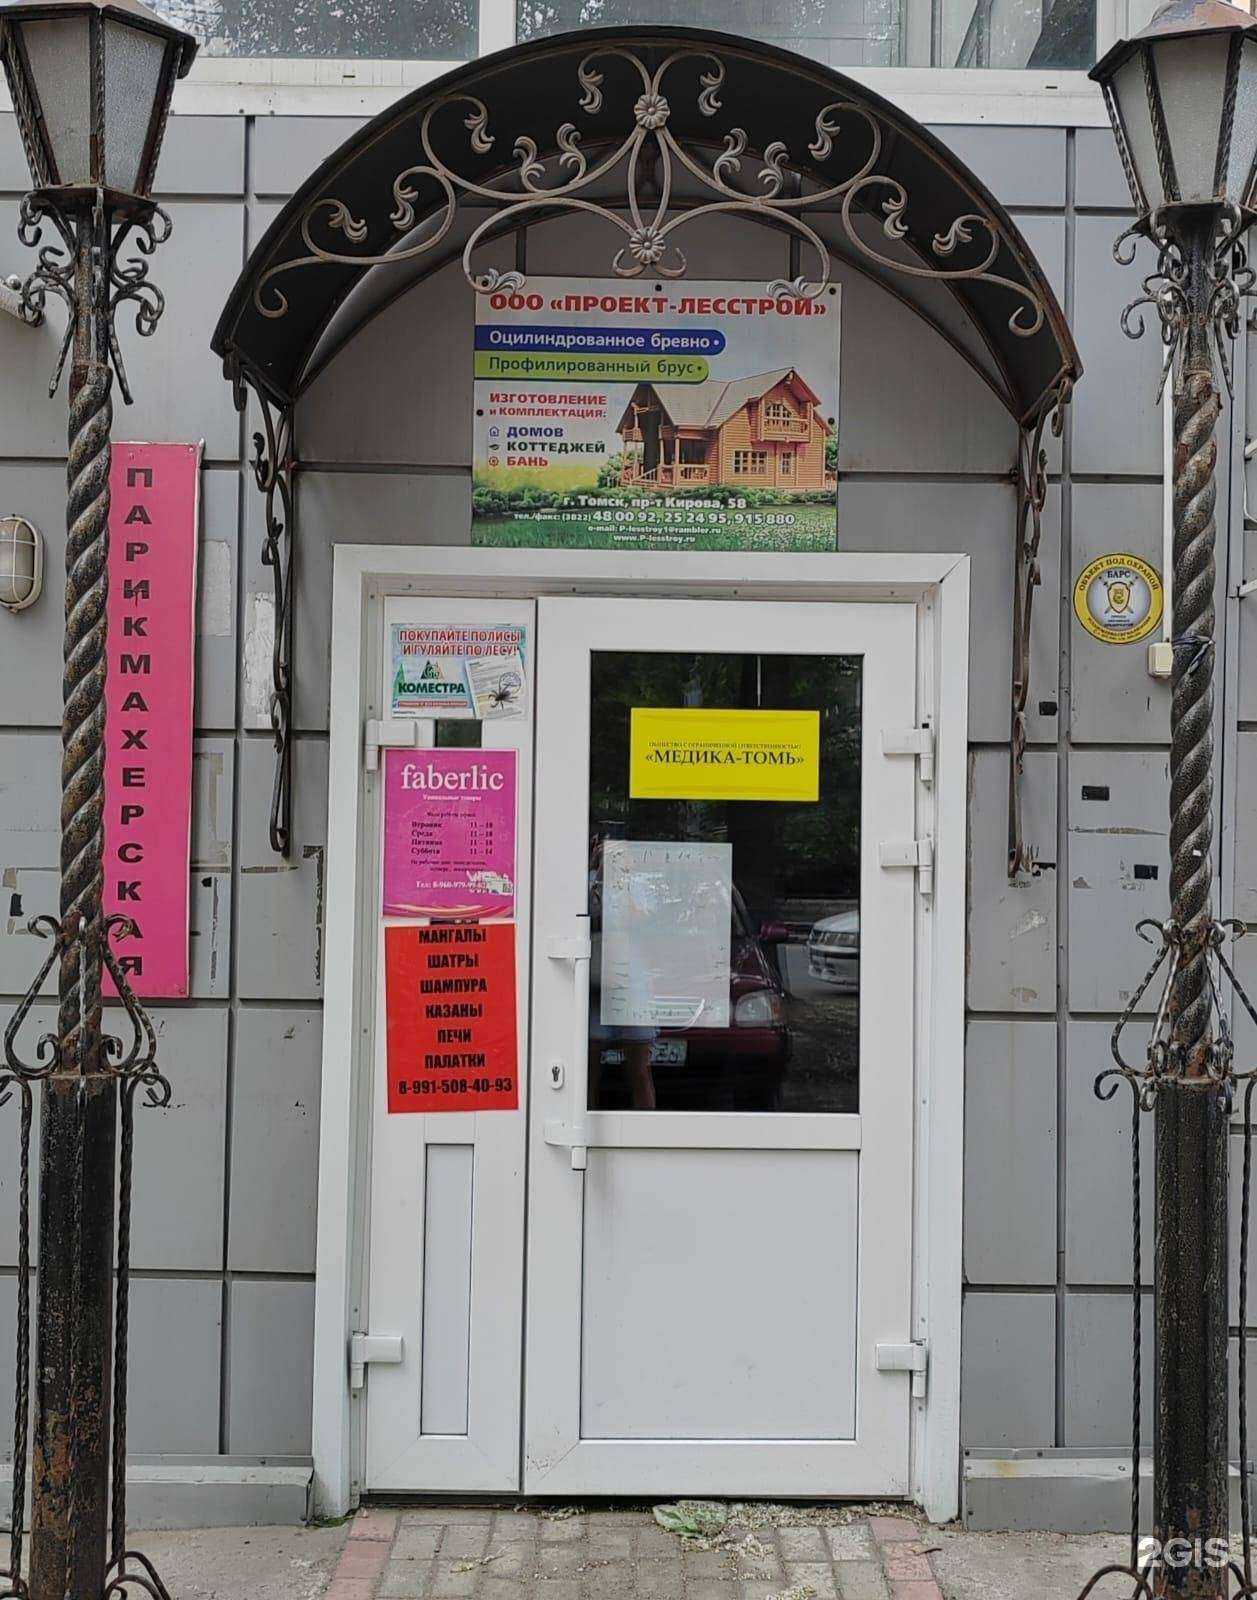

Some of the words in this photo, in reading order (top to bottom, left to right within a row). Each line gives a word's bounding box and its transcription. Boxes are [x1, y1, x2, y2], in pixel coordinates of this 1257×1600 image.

[489, 294, 544, 311] ООО
[550, 295, 827, 316] «ПРОЕКТ-ЛЕССТРОЙ»
[489, 330, 645, 349] Оцилиндрованное
[650, 333, 710, 350] бревно
[489, 356, 651, 376] Профилированный
[656, 359, 695, 377] брус
[489, 392, 607, 406] ИЗГОТОВЛЕНИЕ
[499, 407, 607, 419] КОМПЛЕКТАЦИЯ:
[506, 425, 564, 438] ДОМОВ
[506, 439, 606, 454] КОТТЕДЖЕЙ
[506, 455, 548, 467] БАНЬ
[578, 495, 629, 508] Томск,
[631, 497, 663, 510] пр-т
[665, 497, 724, 511] Кирова,
[727, 498, 747, 509] 58
[1079, 562, 1105, 591] ОБЪЕКТ
[1106, 558, 1125, 566] ПОД
[1107, 570, 1131, 579] БАРС
[399, 628, 469, 641] ПОКУПАЙТЕ
[471, 630, 520, 642] ПОЛИСЫ
[403, 644, 411, 655] И
[414, 643, 463, 656] ГУЛЯЙТЕ
[466, 644, 482, 656] ПО
[398, 682, 466, 694] КОМЕСТРА
[646, 749, 804, 765] «МЕДИКА-ТОМЬ»
[401, 763, 504, 791] faberlic
[418, 927, 487, 944] МАНГАЛЫ
[427, 954, 479, 969] ШАТРЫ
[420, 978, 488, 994] ШАМПУРА
[425, 1003, 483, 1019] КАЗАНЫ
[437, 1028, 472, 1043] ПЕЧИ
[424, 1053, 486, 1069] ПАЛАТКИ
[398, 1077, 513, 1095] 8-991-508-40-93
